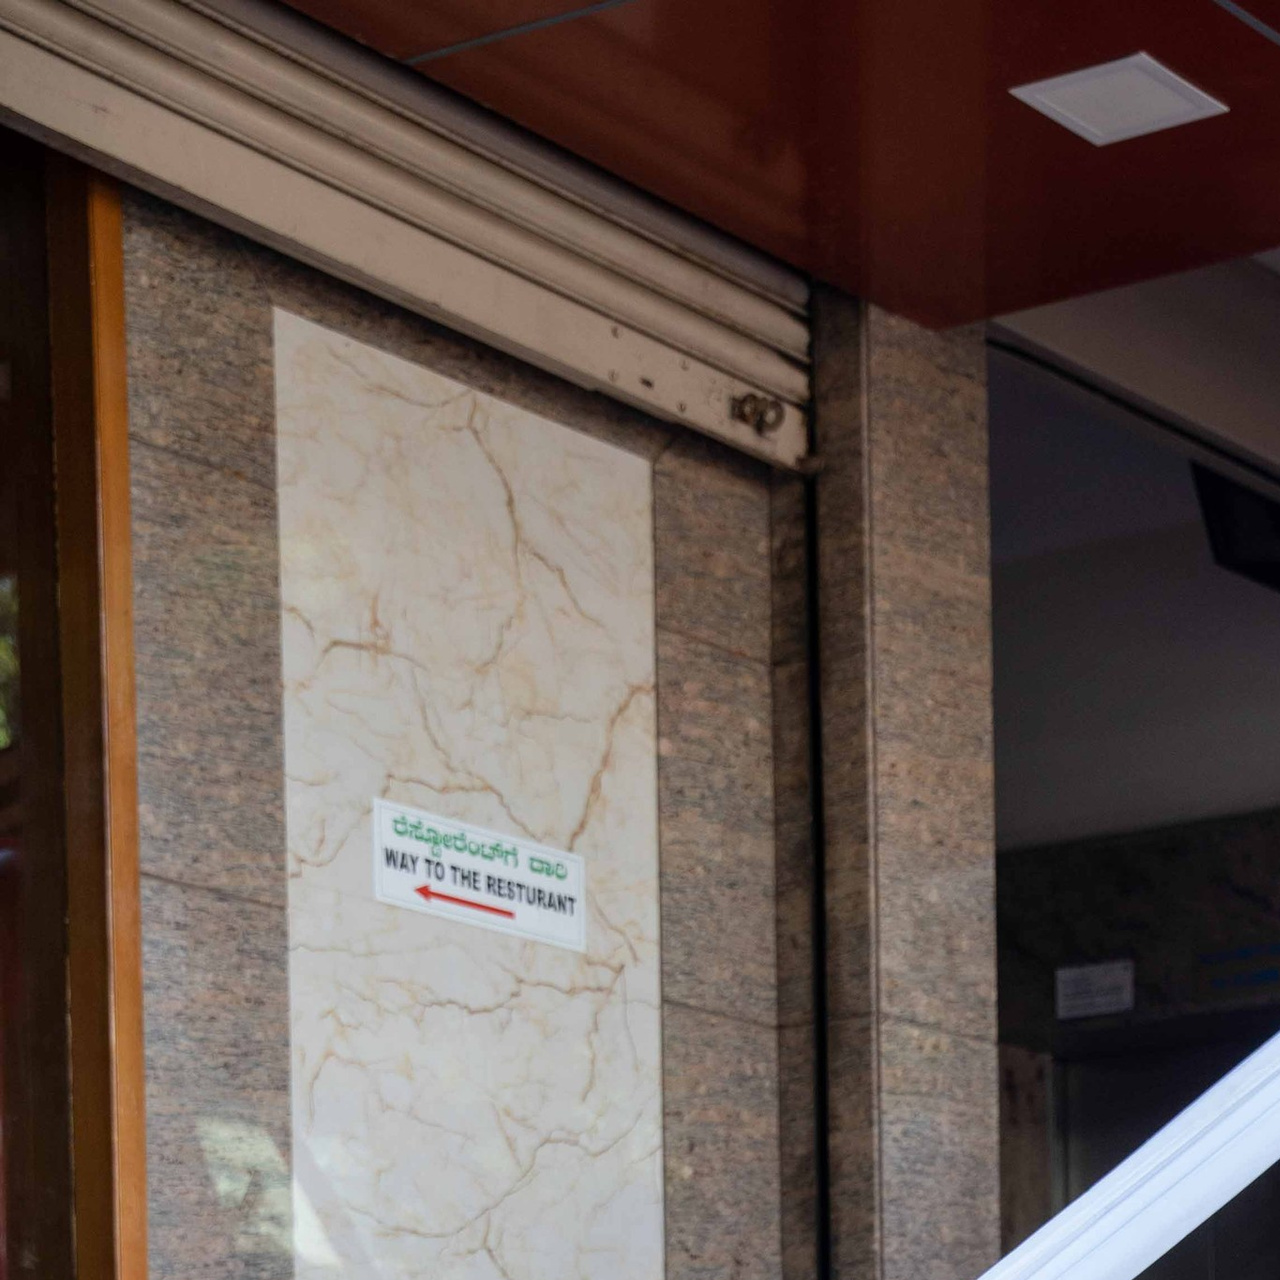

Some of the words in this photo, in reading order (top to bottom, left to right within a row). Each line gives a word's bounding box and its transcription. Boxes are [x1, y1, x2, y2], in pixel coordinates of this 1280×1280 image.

[384, 848, 419, 873] WAY
[425, 858, 445, 881] TO
[450, 866, 480, 891] THE
[487, 874, 577, 916] RESTURANT
[529, 855, 568, 880] ದಾರಿ
